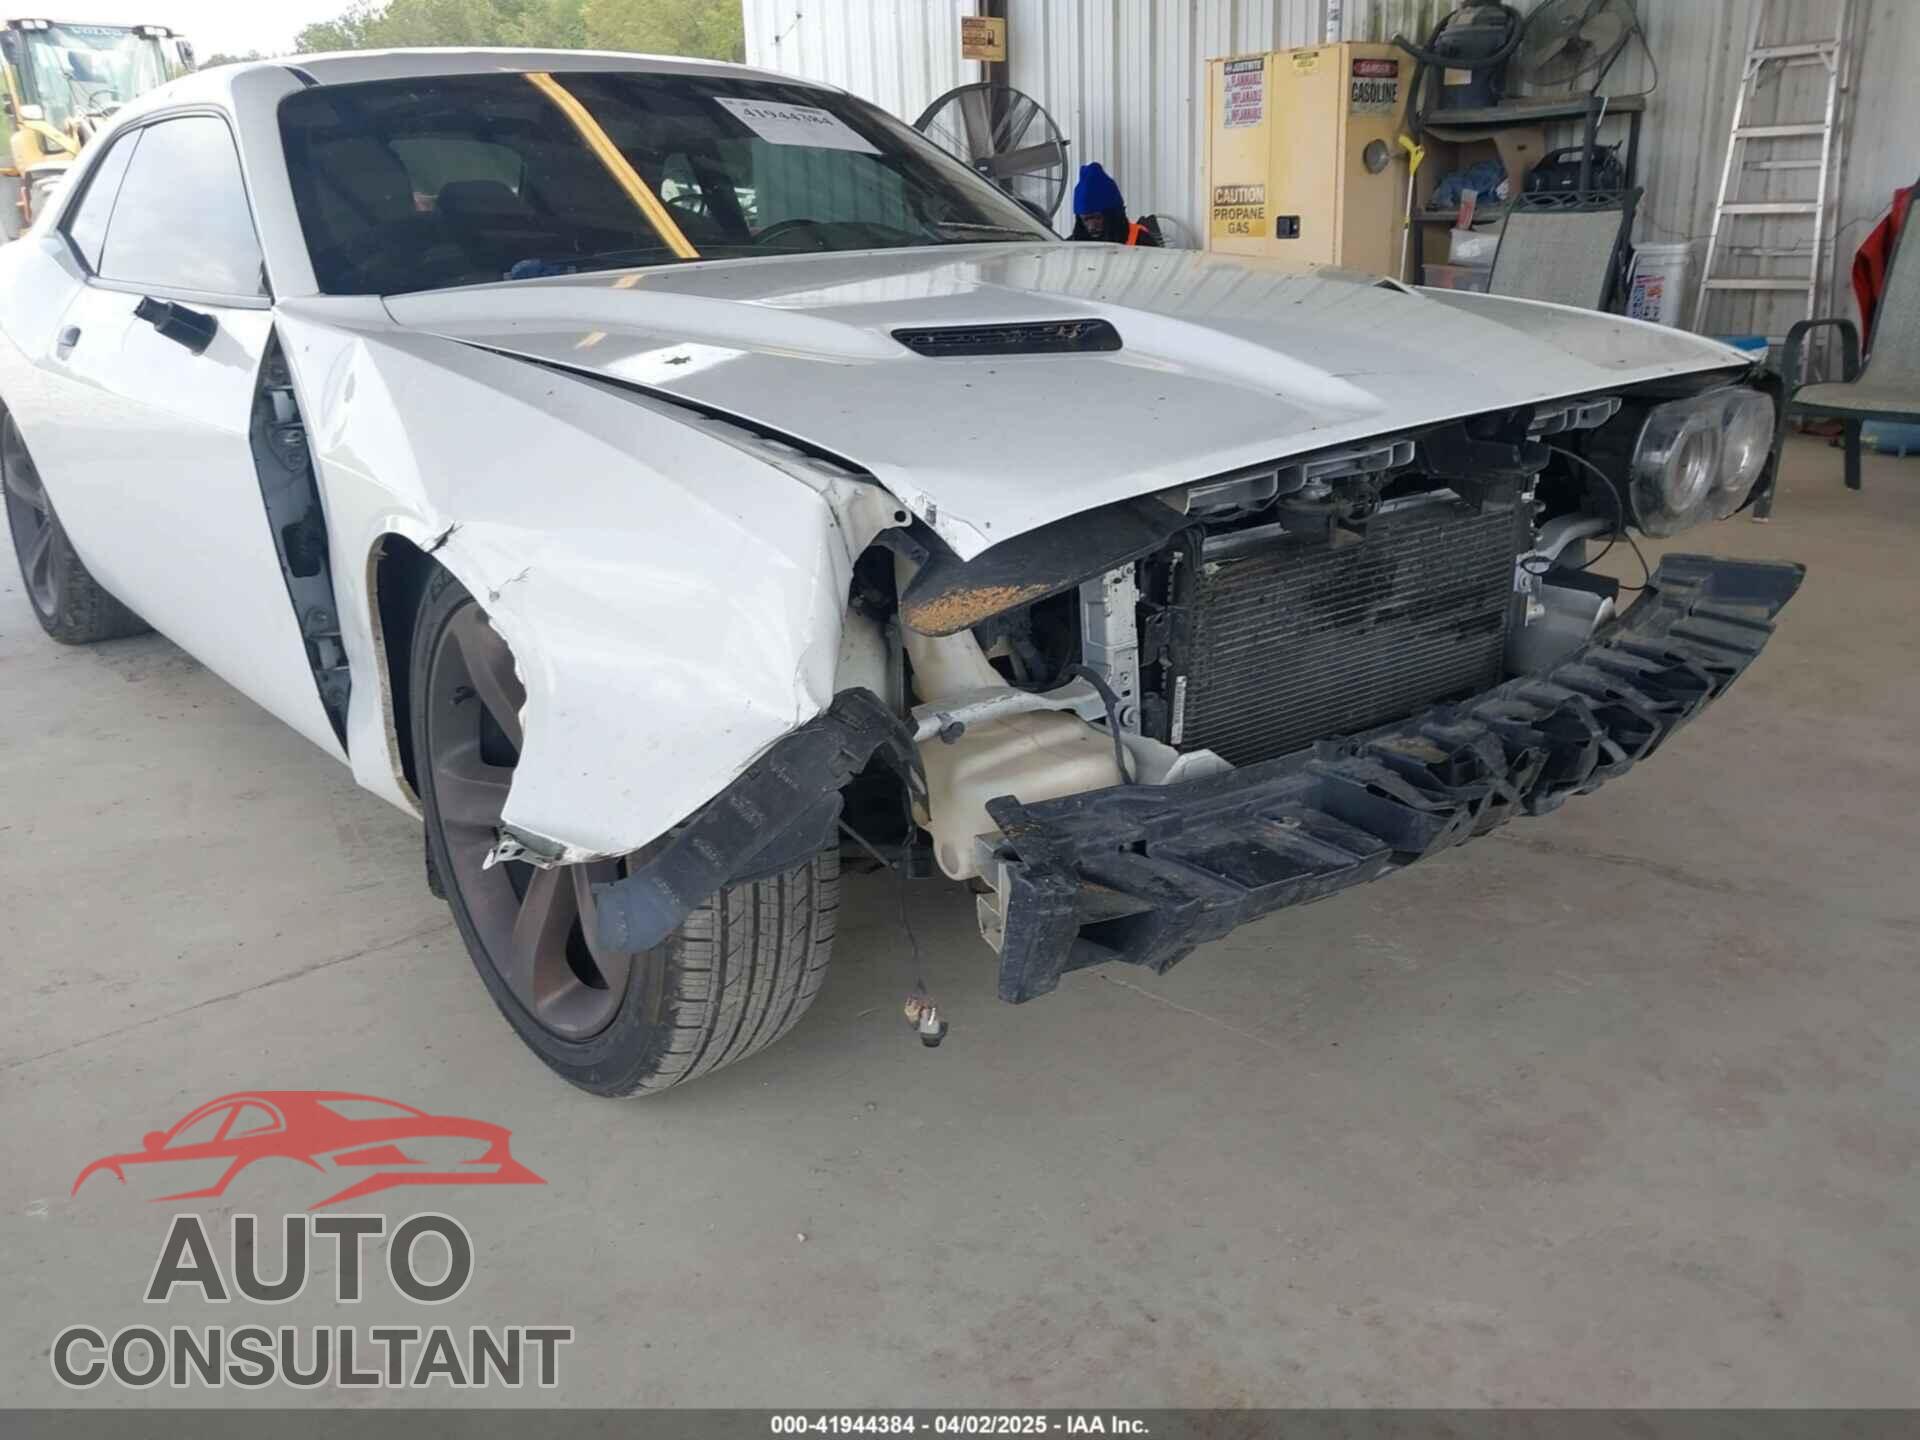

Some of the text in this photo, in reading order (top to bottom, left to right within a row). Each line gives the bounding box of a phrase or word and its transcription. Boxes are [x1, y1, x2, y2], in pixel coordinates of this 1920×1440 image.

[1352, 81, 1398, 103] GASOLINE
[744, 107, 834, 126] 41944384
[1215, 187, 1264, 204] CAUTION
[1214, 207, 1264, 220] PROPANE
[1228, 221, 1249, 234] GAS
